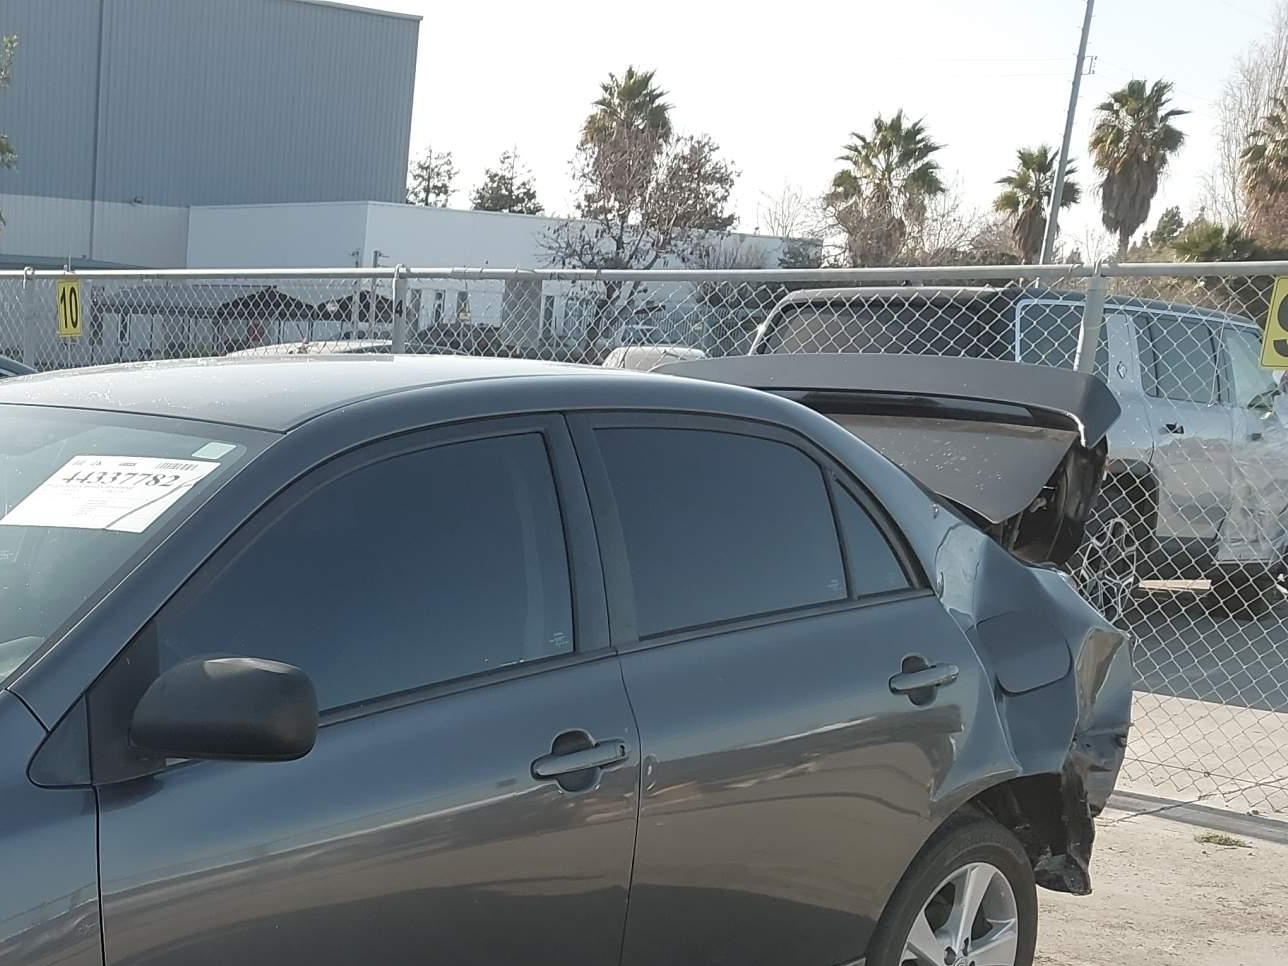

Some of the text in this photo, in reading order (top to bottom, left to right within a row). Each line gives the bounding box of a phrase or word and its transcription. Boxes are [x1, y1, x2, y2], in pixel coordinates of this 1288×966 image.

[60, 286, 79, 329] 10
[394, 299, 404, 318] 4
[62, 471, 180, 487] 44337782
